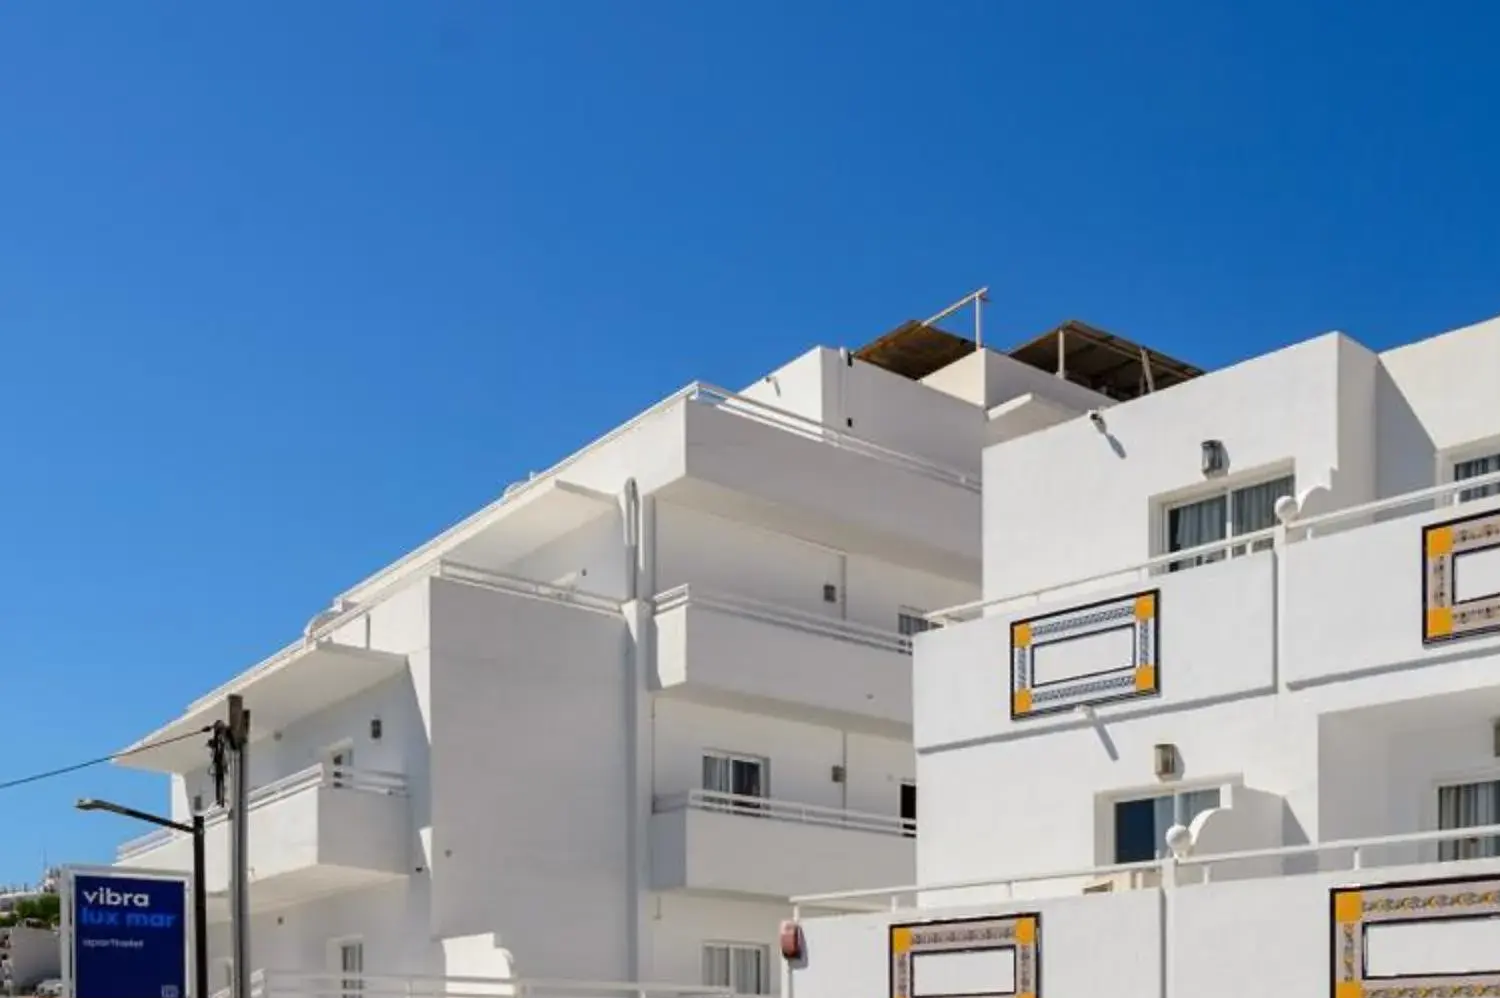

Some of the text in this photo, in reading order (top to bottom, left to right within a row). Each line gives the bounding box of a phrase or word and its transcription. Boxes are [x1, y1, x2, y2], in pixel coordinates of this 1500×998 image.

[83, 887, 149, 907] vibra
[81, 907, 176, 928] lux mar
